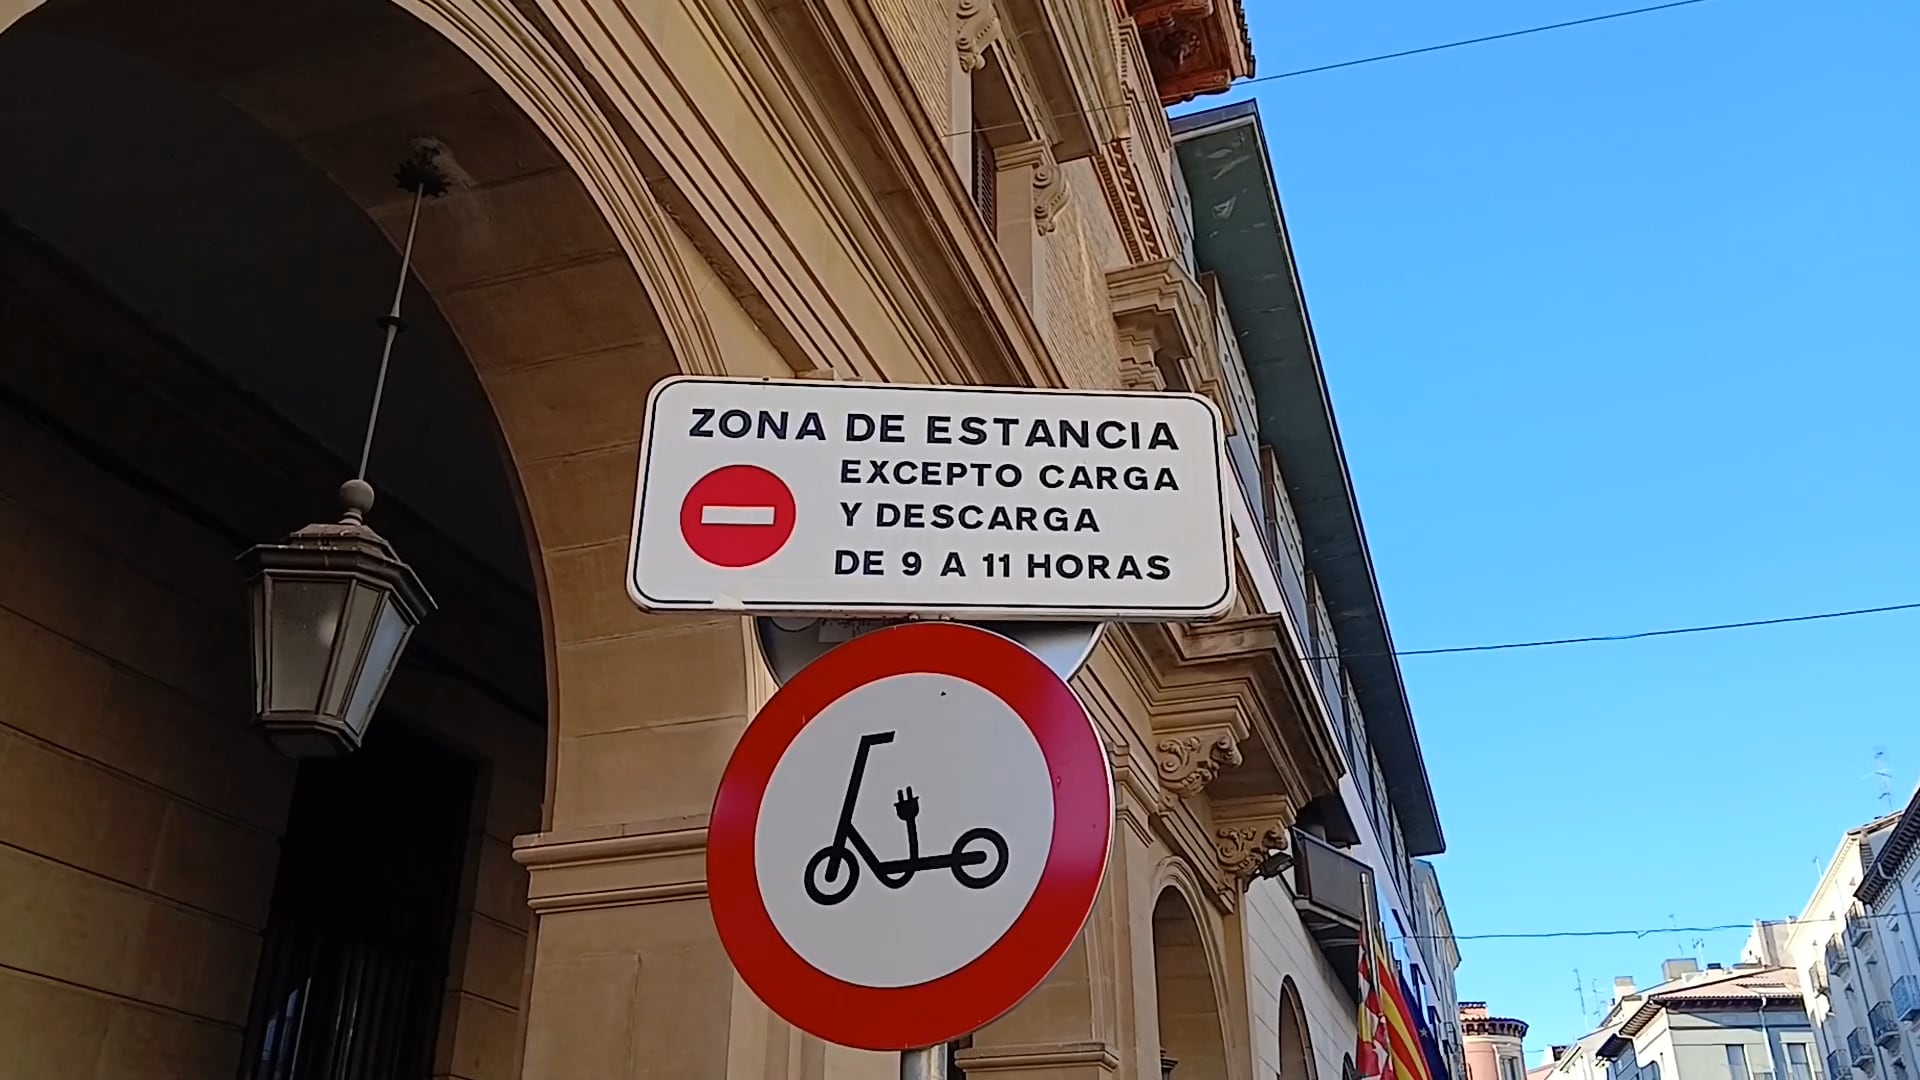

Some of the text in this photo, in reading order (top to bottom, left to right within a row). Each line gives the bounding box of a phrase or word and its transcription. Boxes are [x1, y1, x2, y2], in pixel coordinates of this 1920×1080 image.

[688, 408, 1180, 451] ZONA DE ESTANCIA
[840, 459, 1180, 491] EXCEPTO CARGA
[839, 501, 1101, 533] Y DESCARGA
[834, 549, 1171, 581] DE 9 A 11 HORAS
